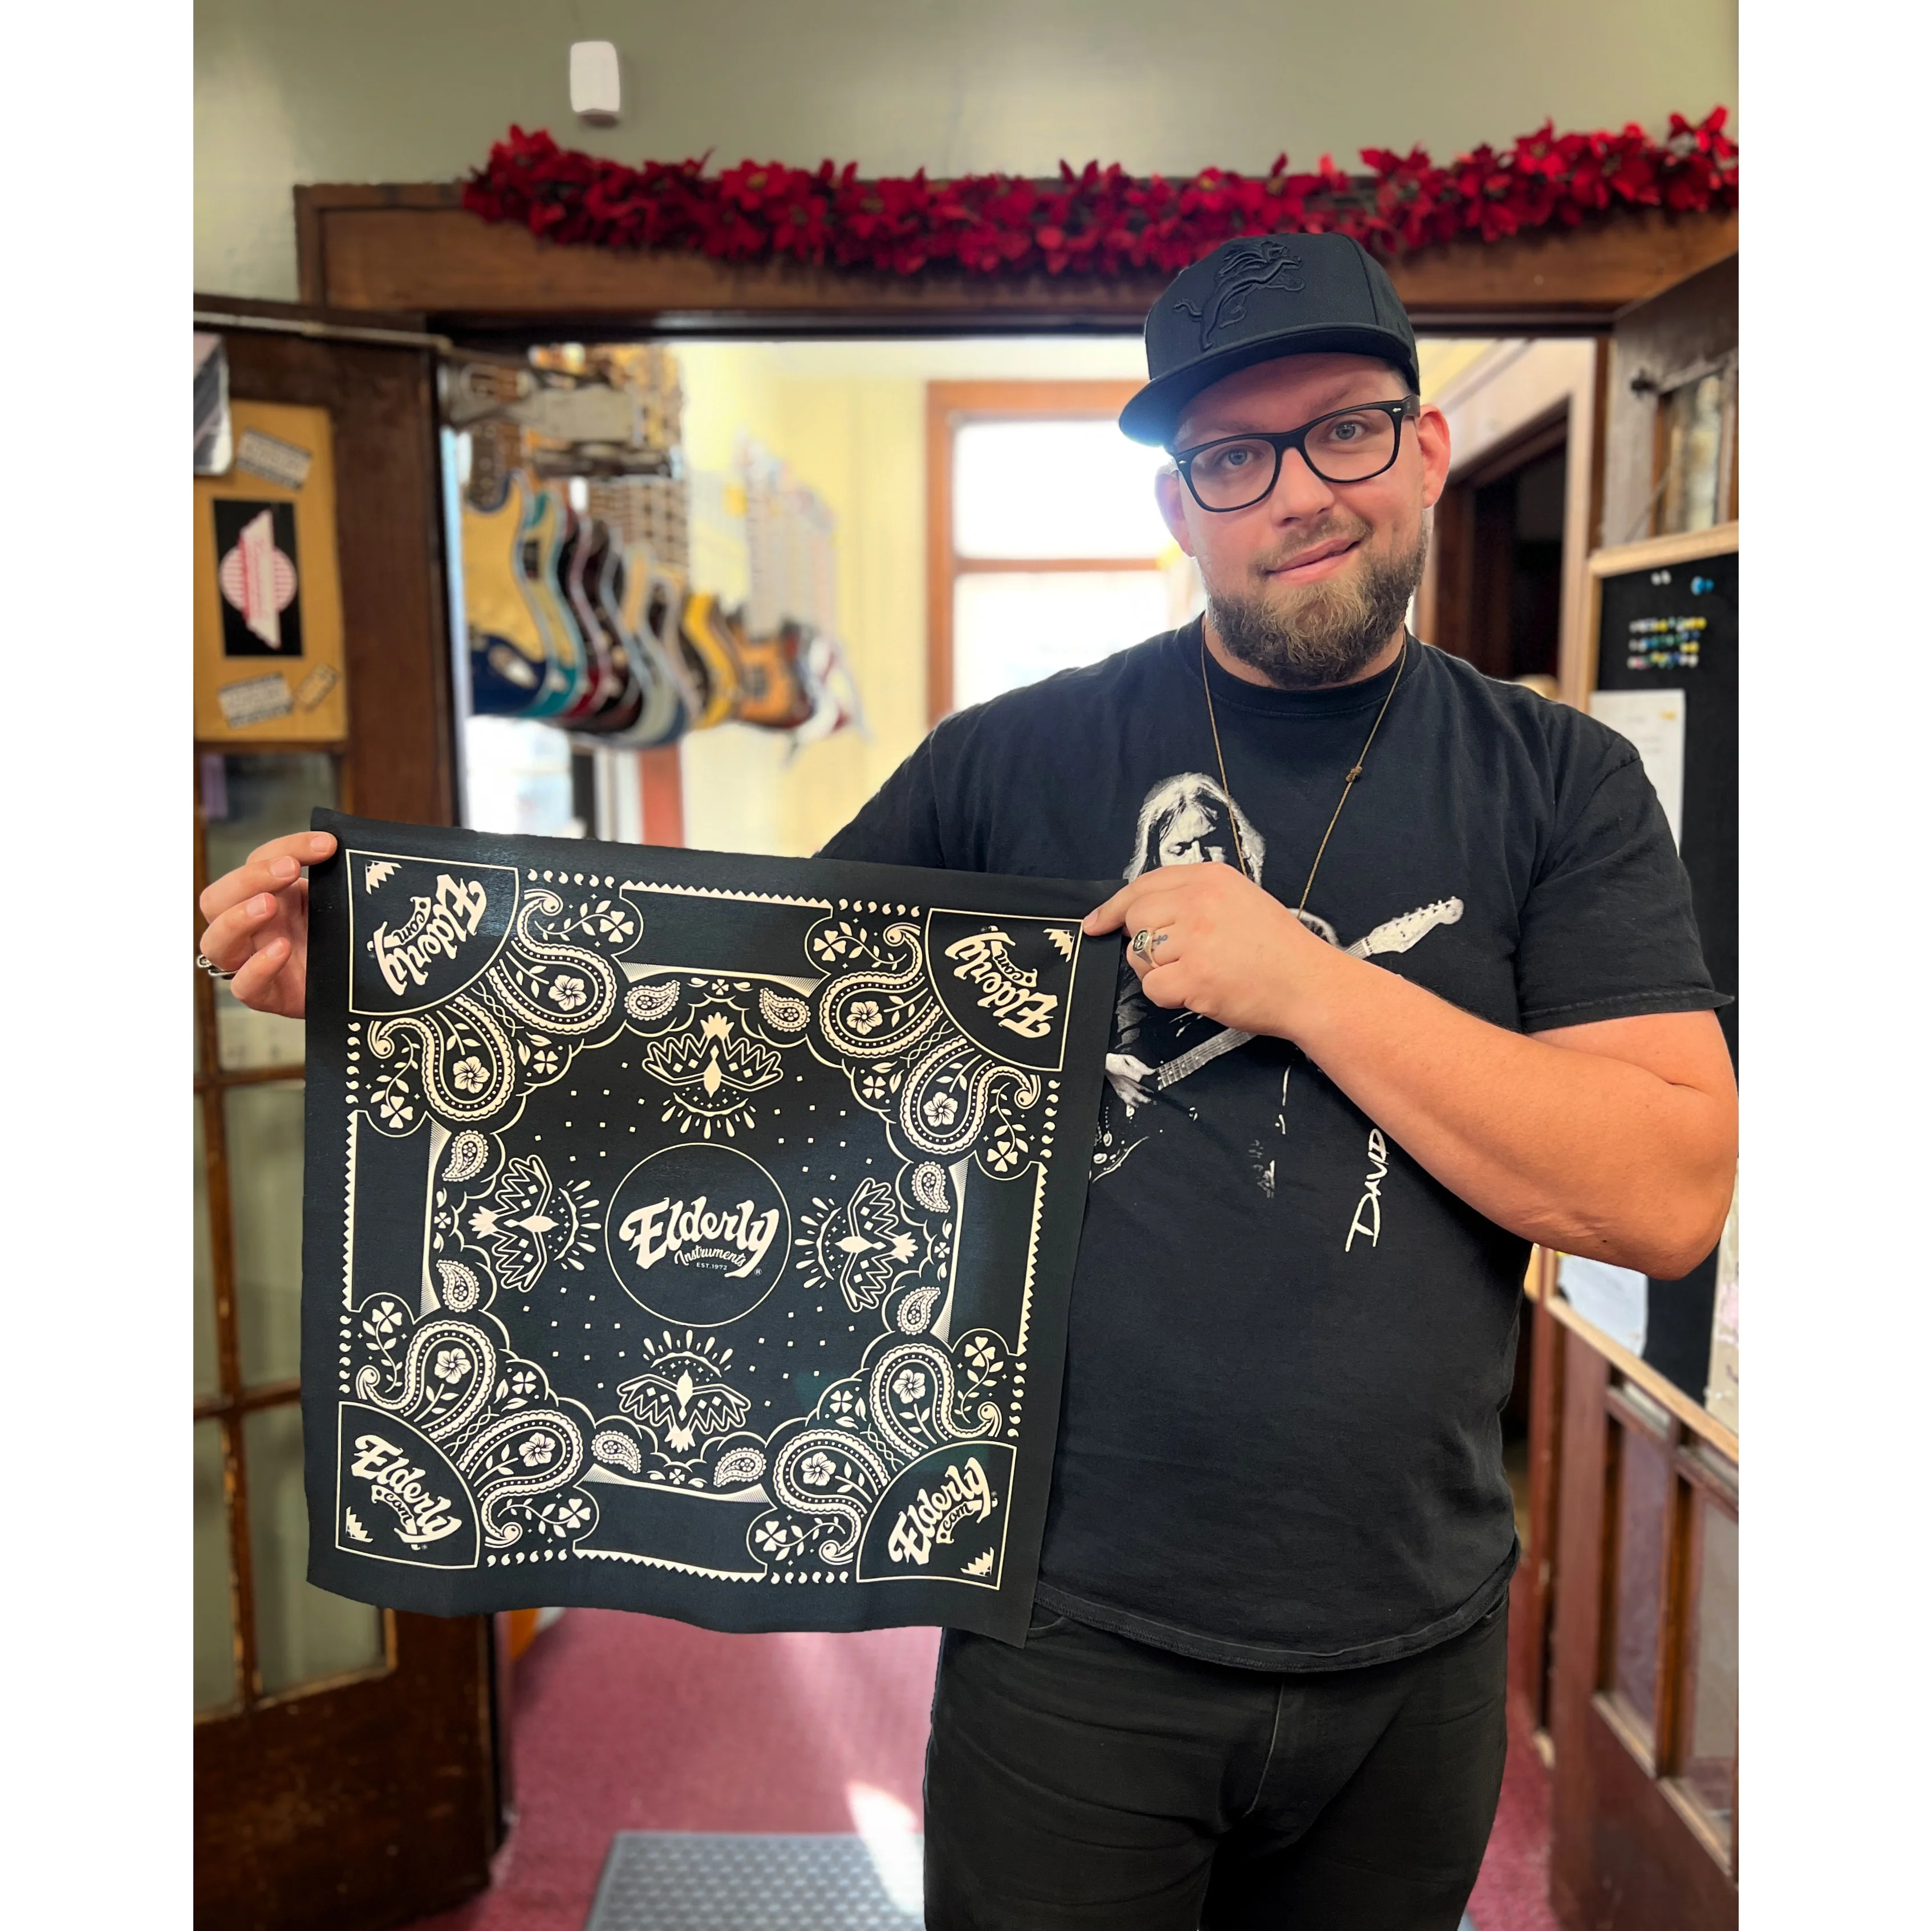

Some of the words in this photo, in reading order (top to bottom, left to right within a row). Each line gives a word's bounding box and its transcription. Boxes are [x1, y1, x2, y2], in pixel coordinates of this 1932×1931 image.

[374, 873, 487, 996] Elderly
[944, 932, 1058, 1038] Elderly
[619, 1196, 780, 1278] Elderly
[1345, 1128, 1390, 1252] DAVID
[674, 1245, 747, 1267] Instruments
[351, 1434, 462, 1543] Elderly
[888, 1457, 991, 1566] Elderly
